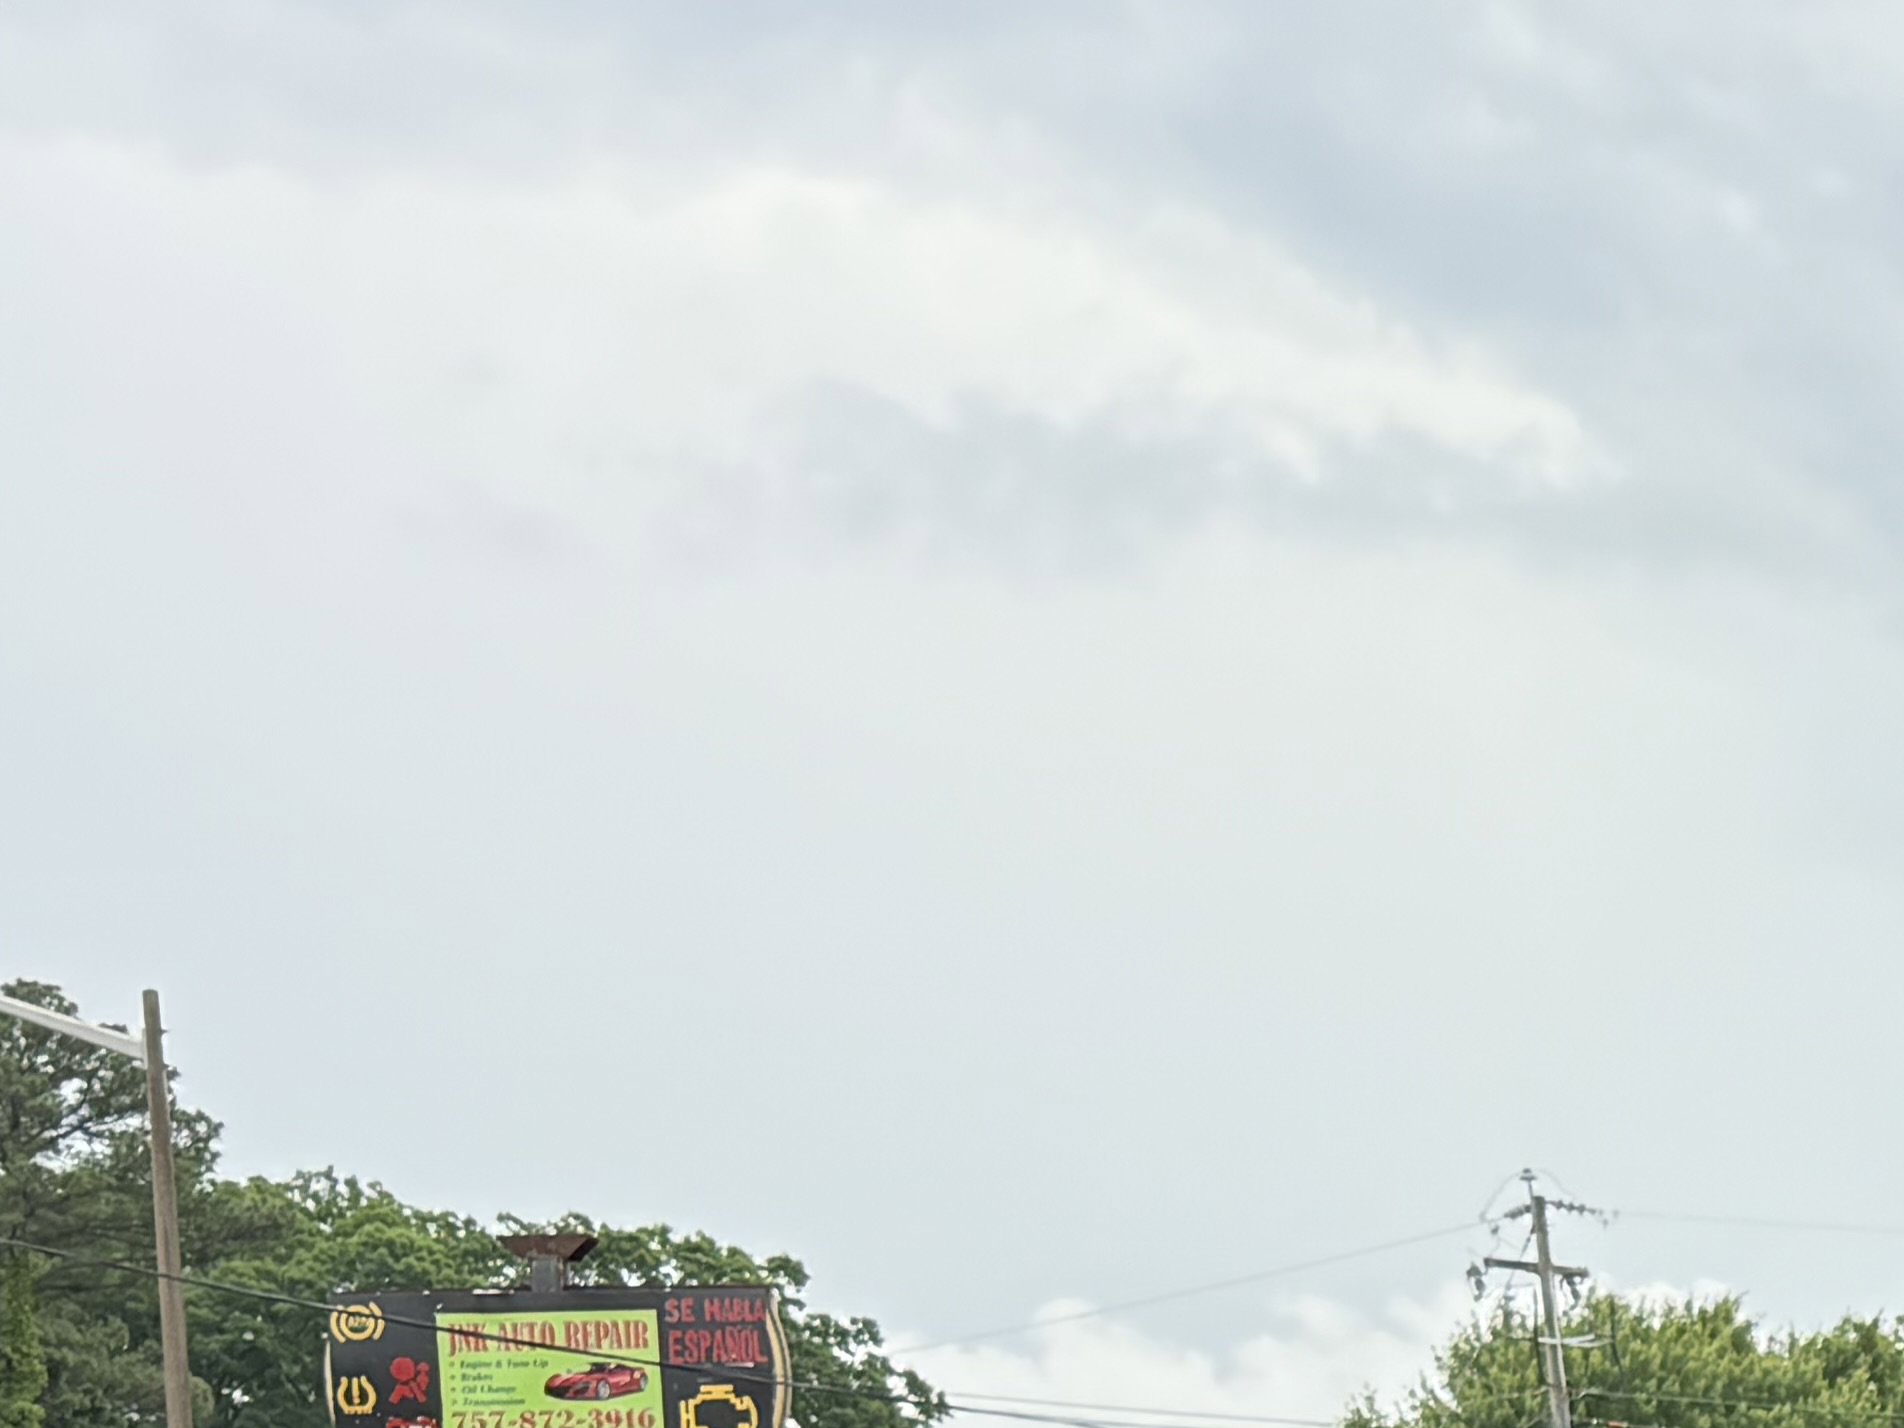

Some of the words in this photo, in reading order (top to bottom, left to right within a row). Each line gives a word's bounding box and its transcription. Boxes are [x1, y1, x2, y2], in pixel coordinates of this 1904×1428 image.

[664, 1297, 695, 1323] SE
[704, 1297, 766, 1322] HABLA
[448, 1322, 488, 1357] JNK
[498, 1321, 556, 1352] AUTO
[564, 1319, 650, 1350] REPAIR
[668, 1324, 768, 1363] ESPAÑOL
